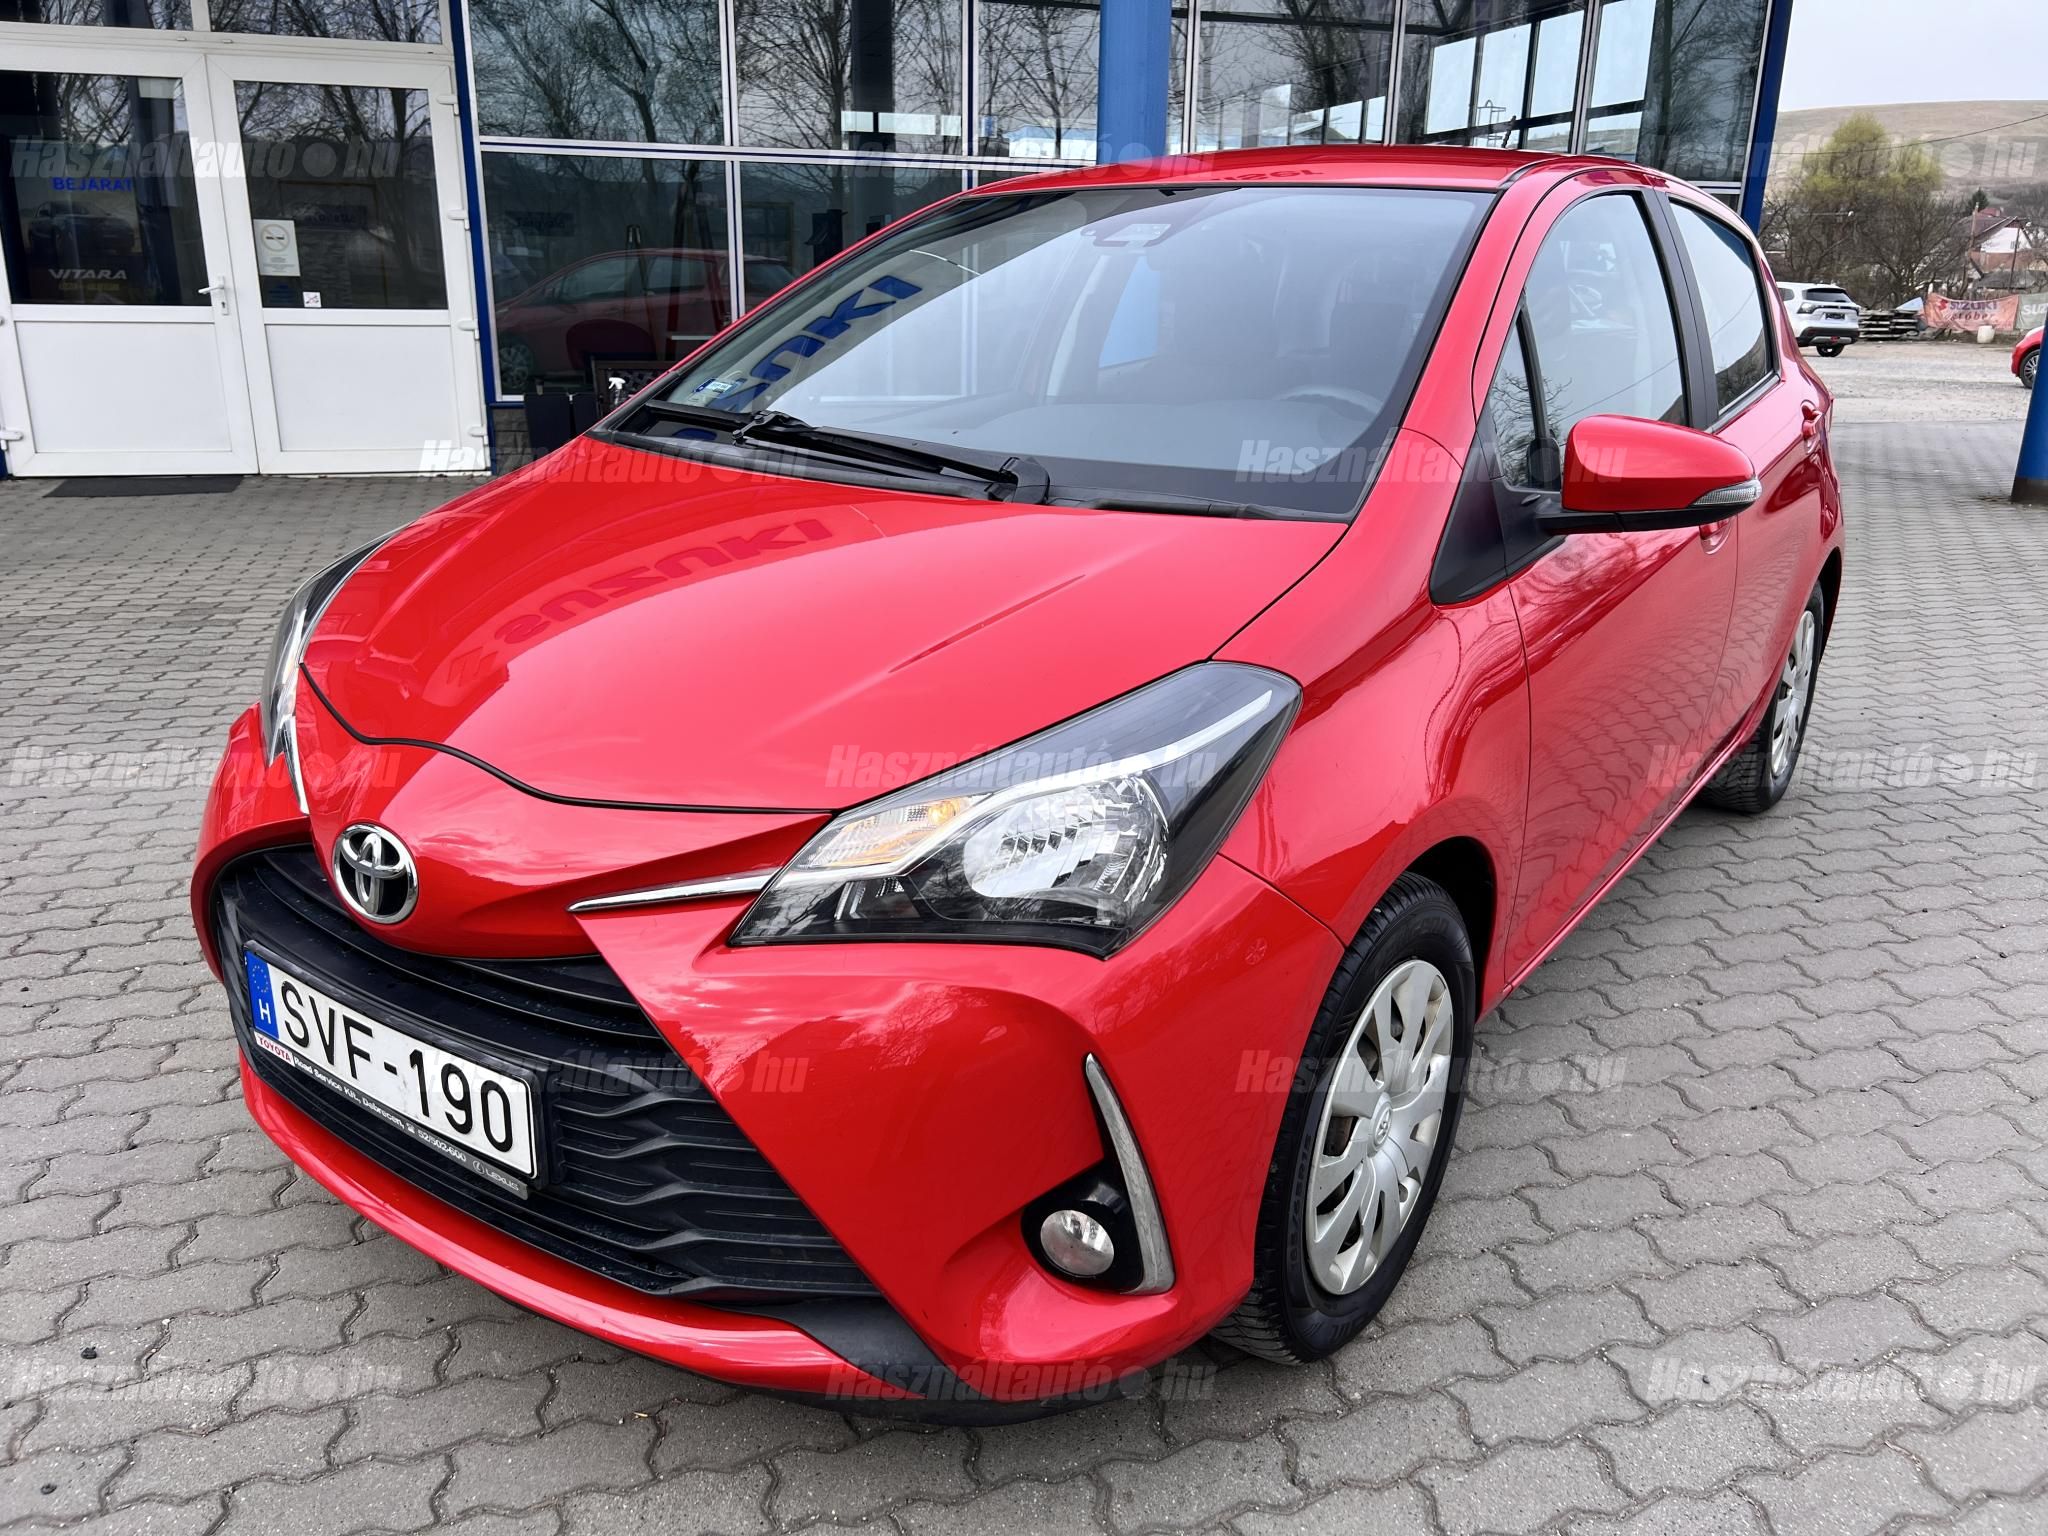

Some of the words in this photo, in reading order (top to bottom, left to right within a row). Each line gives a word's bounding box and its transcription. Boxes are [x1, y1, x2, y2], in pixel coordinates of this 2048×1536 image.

[48, 269, 127, 280] VITARA
[1950, 300, 1998, 311] SUZUKI
[259, 999, 272, 1024] H
[281, 980, 513, 1153] SVF-190
[258, 1036, 292, 1062] TOYOTA
[485, 1168, 520, 1192] LEXUS
